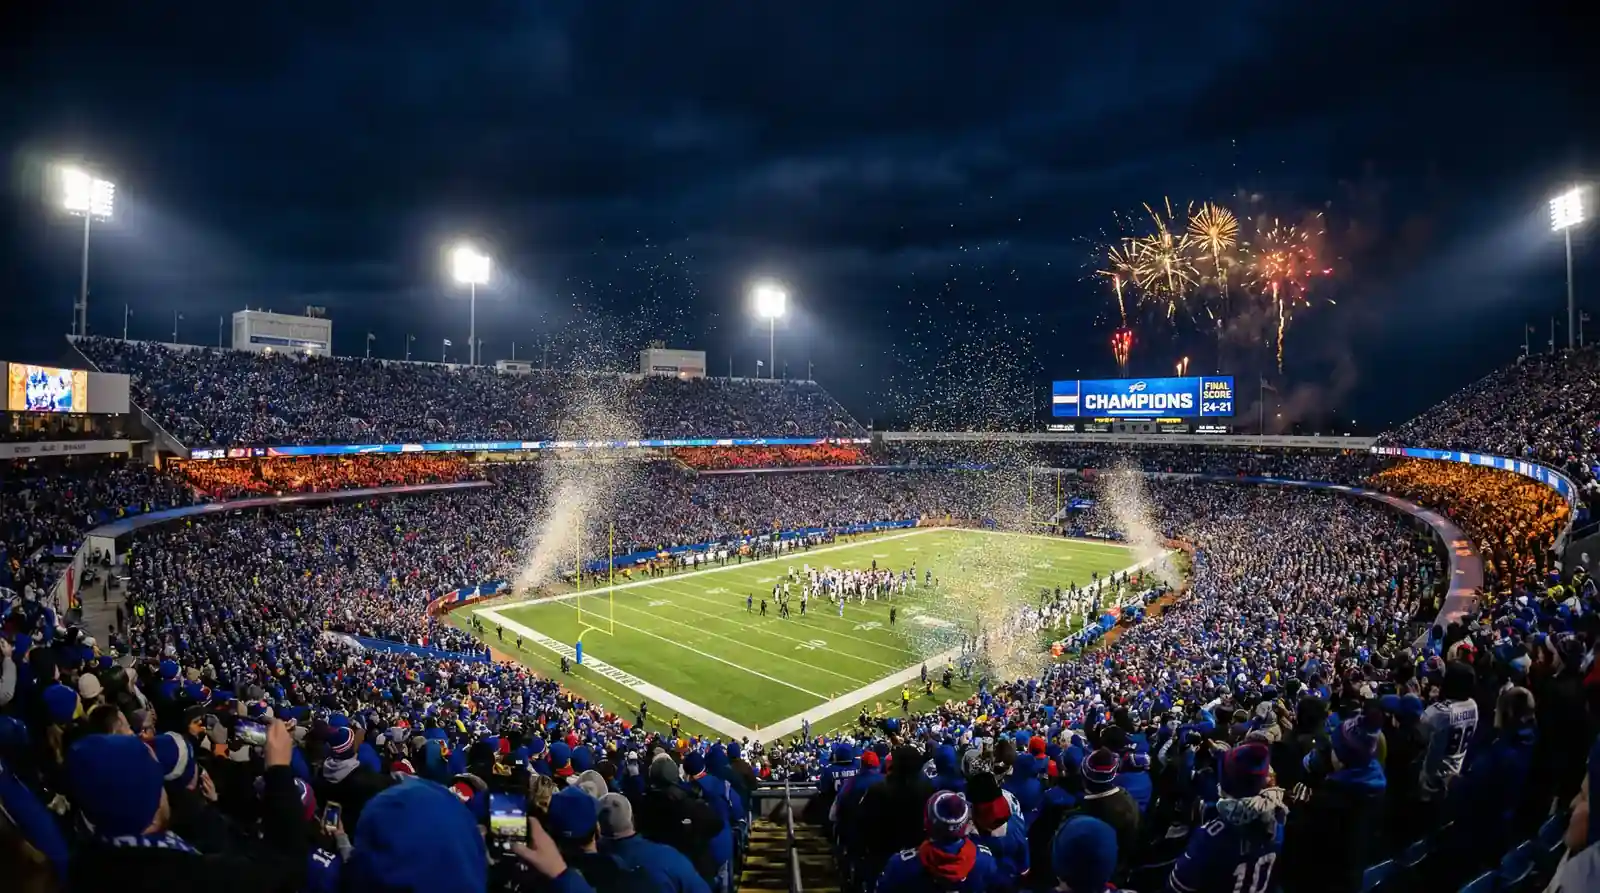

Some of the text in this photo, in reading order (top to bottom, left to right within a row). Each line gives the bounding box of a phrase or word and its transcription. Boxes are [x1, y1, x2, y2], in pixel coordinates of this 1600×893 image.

[1205, 382, 1230, 390] FINAL
[1203, 390, 1232, 399] SCORE
[1085, 392, 1193, 409] CHAMPIONS
[1203, 402, 1231, 412] 24-21
[1232, 852, 1277, 893] 10
